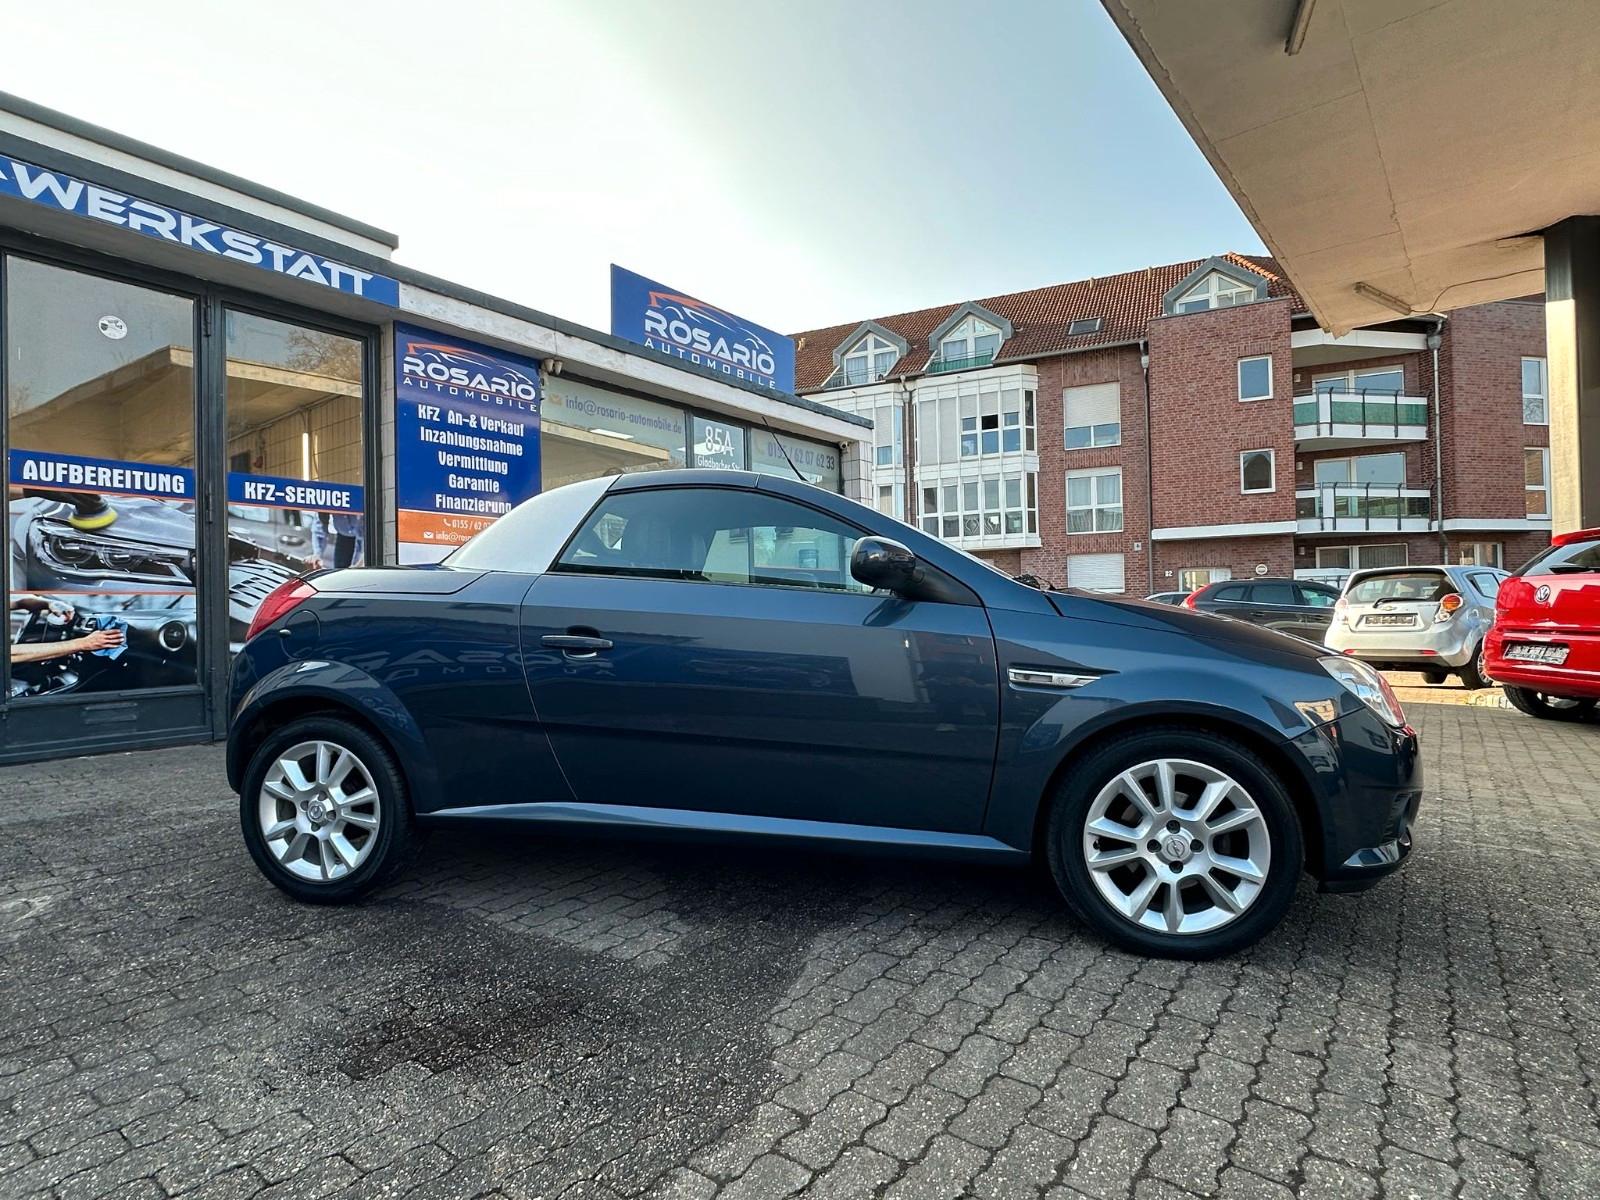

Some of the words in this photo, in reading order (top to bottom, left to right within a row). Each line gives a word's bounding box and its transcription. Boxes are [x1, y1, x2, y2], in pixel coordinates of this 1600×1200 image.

[644, 309, 776, 375] ROSARIO
[403, 356, 536, 401] ROSARIO
[644, 338, 776, 390] AUTOMOBILE
[403, 376, 537, 412] AUTOMOBILE
[418, 404, 440, 422] KFZ
[480, 415, 525, 437] Verkauf
[565, 395, 682, 434] info@rosario-automobile.de
[420, 426, 523, 456] Inzahlungsnahme
[705, 425, 734, 457] 85A
[438, 451, 508, 475] Vermittlung
[794, 447, 804, 464] 62
[805, 450, 814, 465] 07
[816, 453, 825, 468] 62
[826, 455, 835, 470] 33
[23, 459, 185, 494] AUFBEREITUNG
[449, 473, 500, 493] Garantie
[244, 481, 351, 508] KFZ-SERVICE
[435, 494, 512, 514] Finanzierung
[452, 519, 468, 529] 0155
